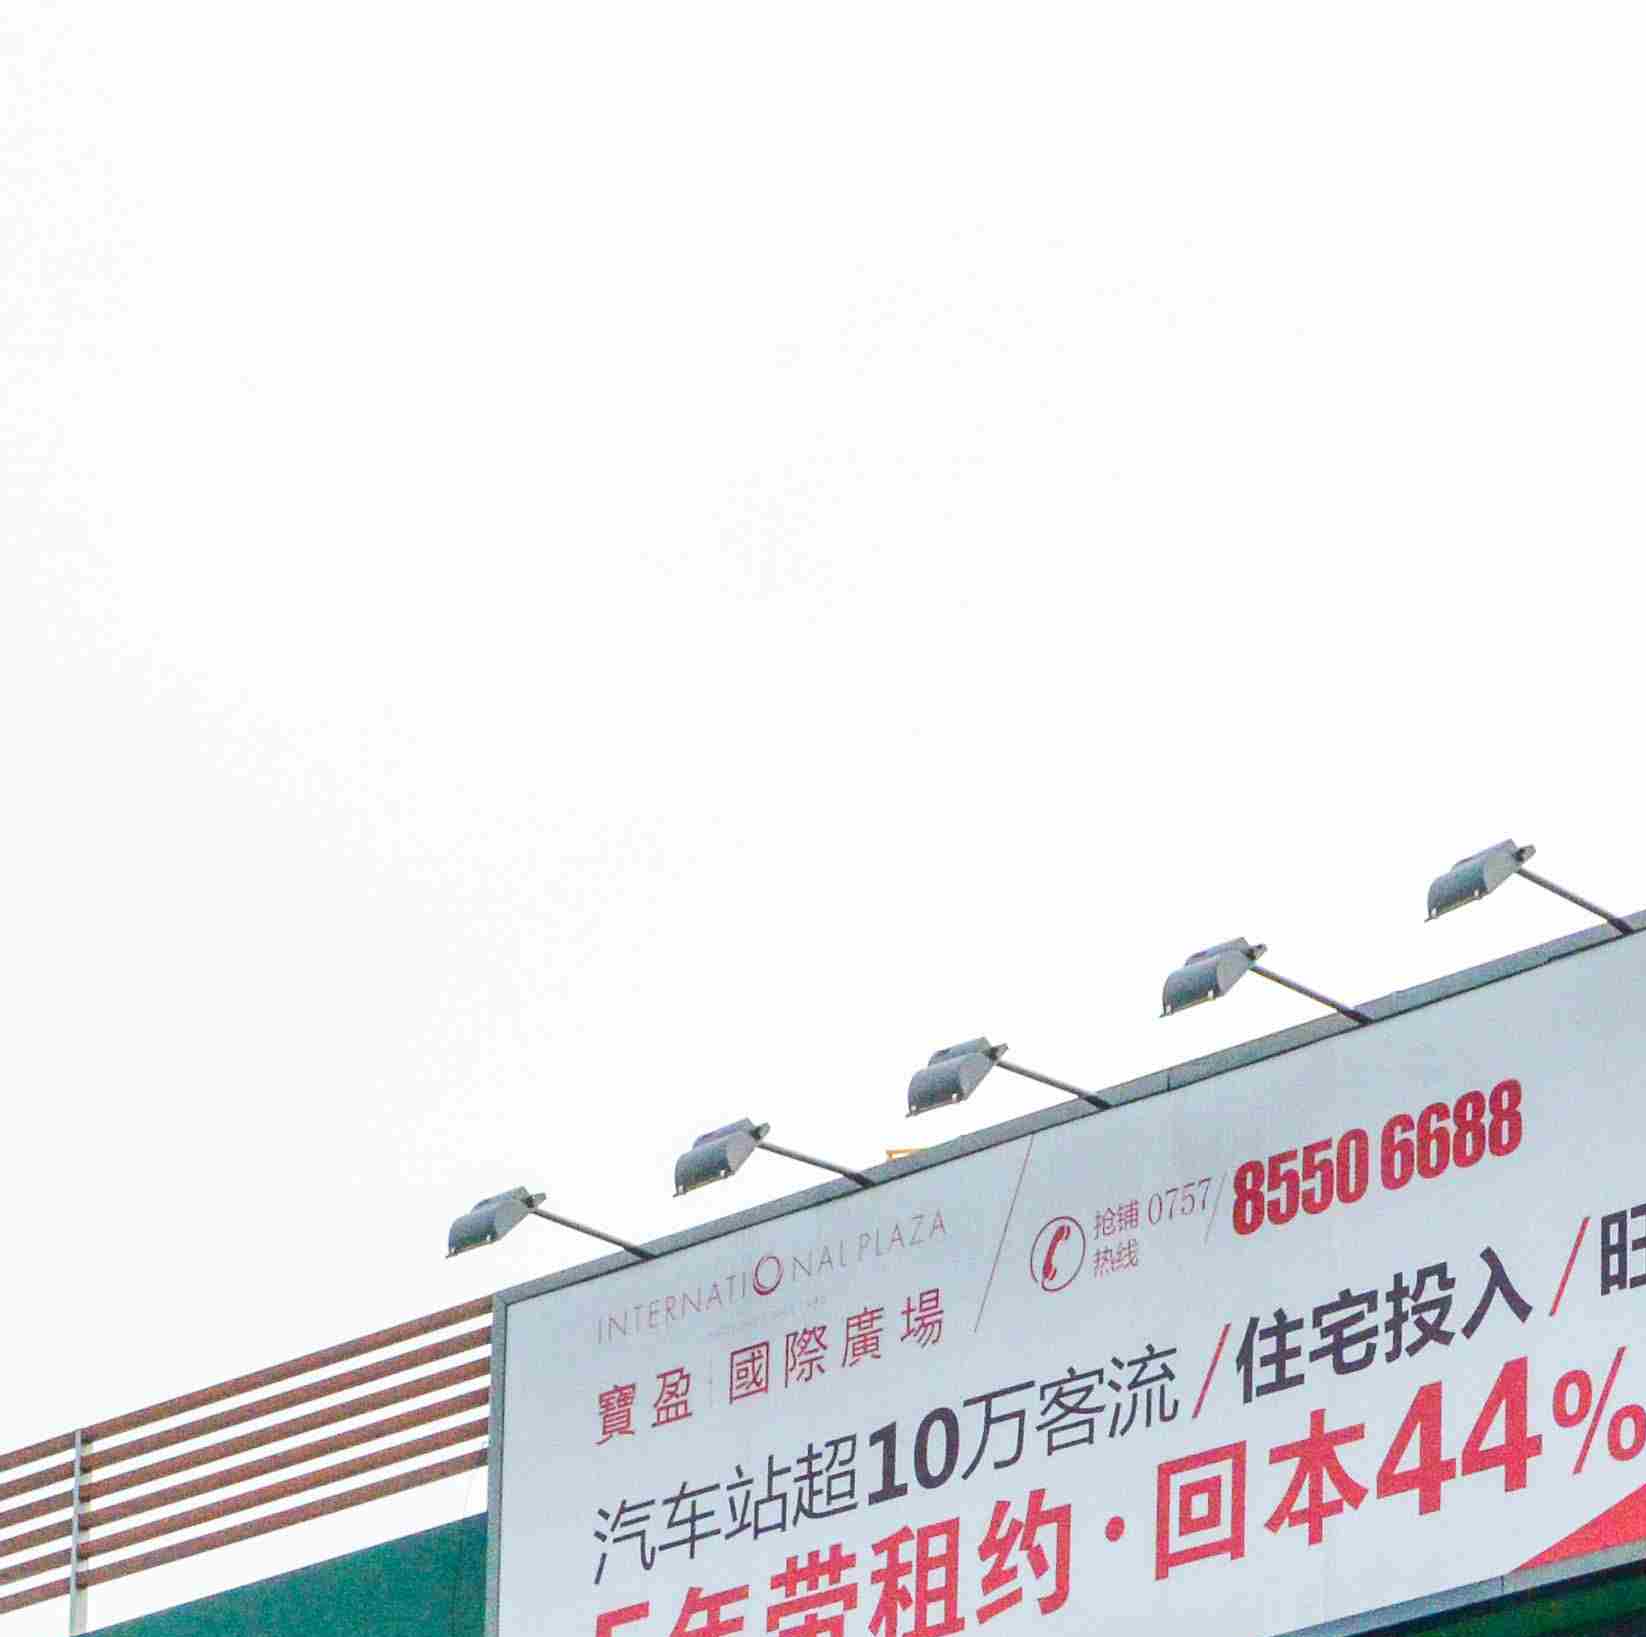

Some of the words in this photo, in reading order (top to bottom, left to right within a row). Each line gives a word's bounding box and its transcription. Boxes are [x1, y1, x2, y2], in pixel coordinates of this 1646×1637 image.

[1147, 1177, 1213, 1226] 0757
[1232, 1128, 1369, 1236] 8550
[1380, 1078, 1523, 1190] 6688
[596, 1237, 850, 1346] INTERNATIONAL
[857, 1207, 948, 1262] PLAZA
[1093, 1240, 1139, 1279] 热线
